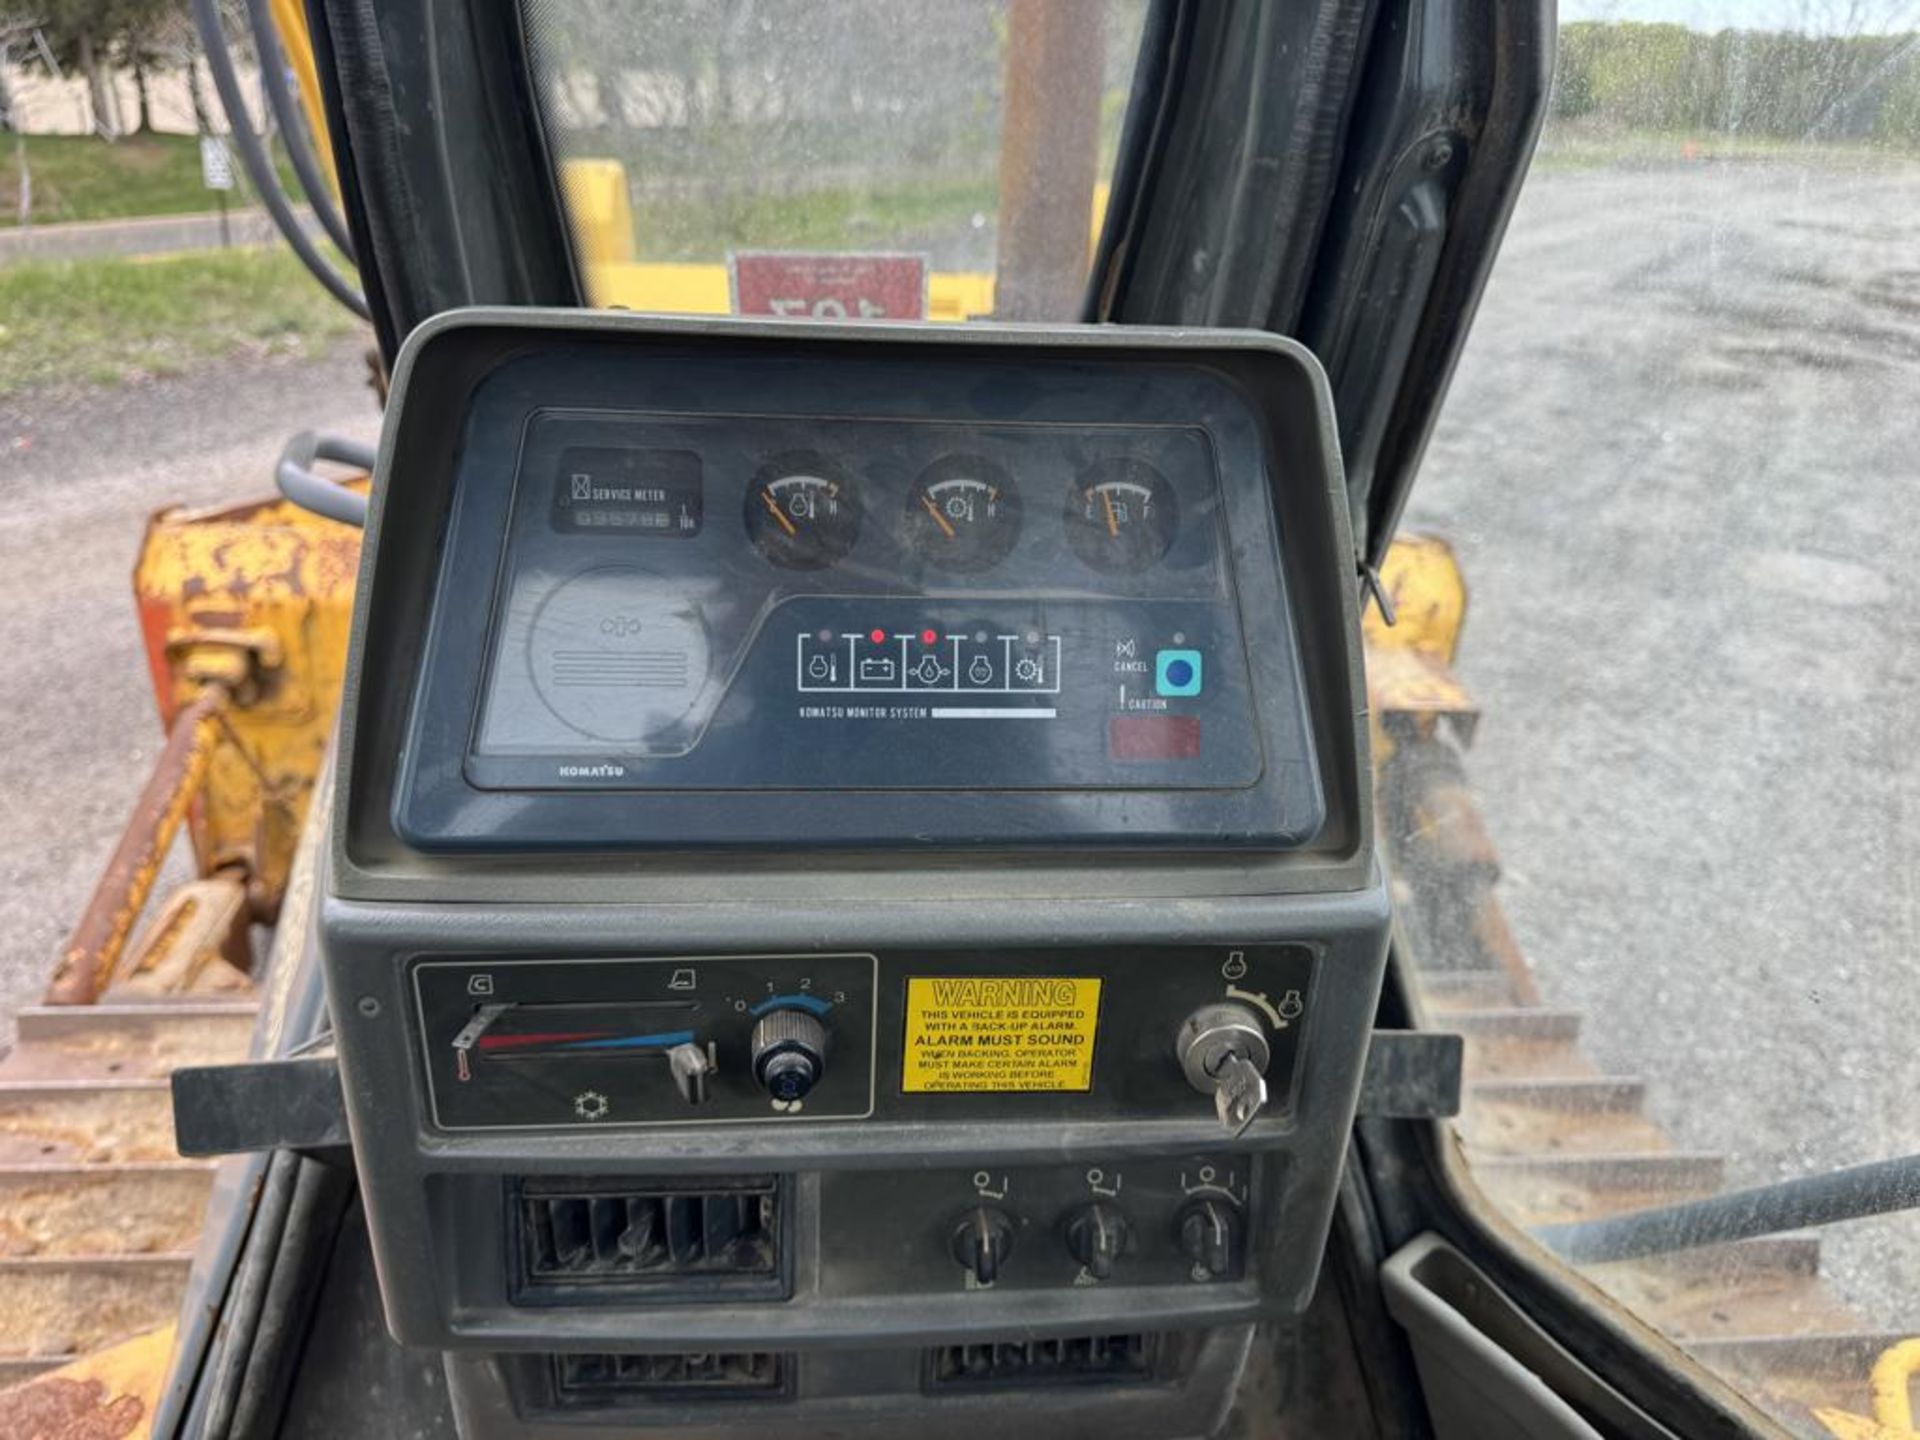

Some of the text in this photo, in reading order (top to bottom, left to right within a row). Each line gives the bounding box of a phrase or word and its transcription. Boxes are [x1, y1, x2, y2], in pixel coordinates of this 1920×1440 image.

[592, 488, 665, 501] SERVICE METER
[1113, 661, 1149, 673] CANCEL
[799, 707, 928, 719] KOMATSU MONITOR SYSTEM
[559, 764, 624, 777] KOMATSU
[800, 978, 812, 990] 2
[833, 991, 846, 1003] 3
[931, 979, 1077, 1008] WARNING
[921, 1010, 1085, 1020] THIS VEHICLE IS EQUIPPED
[924, 1022, 956, 1031] WITH
[959, 1022, 968, 1031] A
[914, 1034, 1085, 1047] ALARM MUST SOUND
[921, 1050, 956, 1059] WHEN
[1014, 1049, 1077, 1058] OPERATOR
[918, 1059, 1078, 1069] MUST MAKE CERTAIN ALARM
[938, 1071, 1055, 1079] IS WORKING BEFORE
[923, 1081, 988, 1090] OPERATING
[992, 1081, 1015, 1089] THIS
